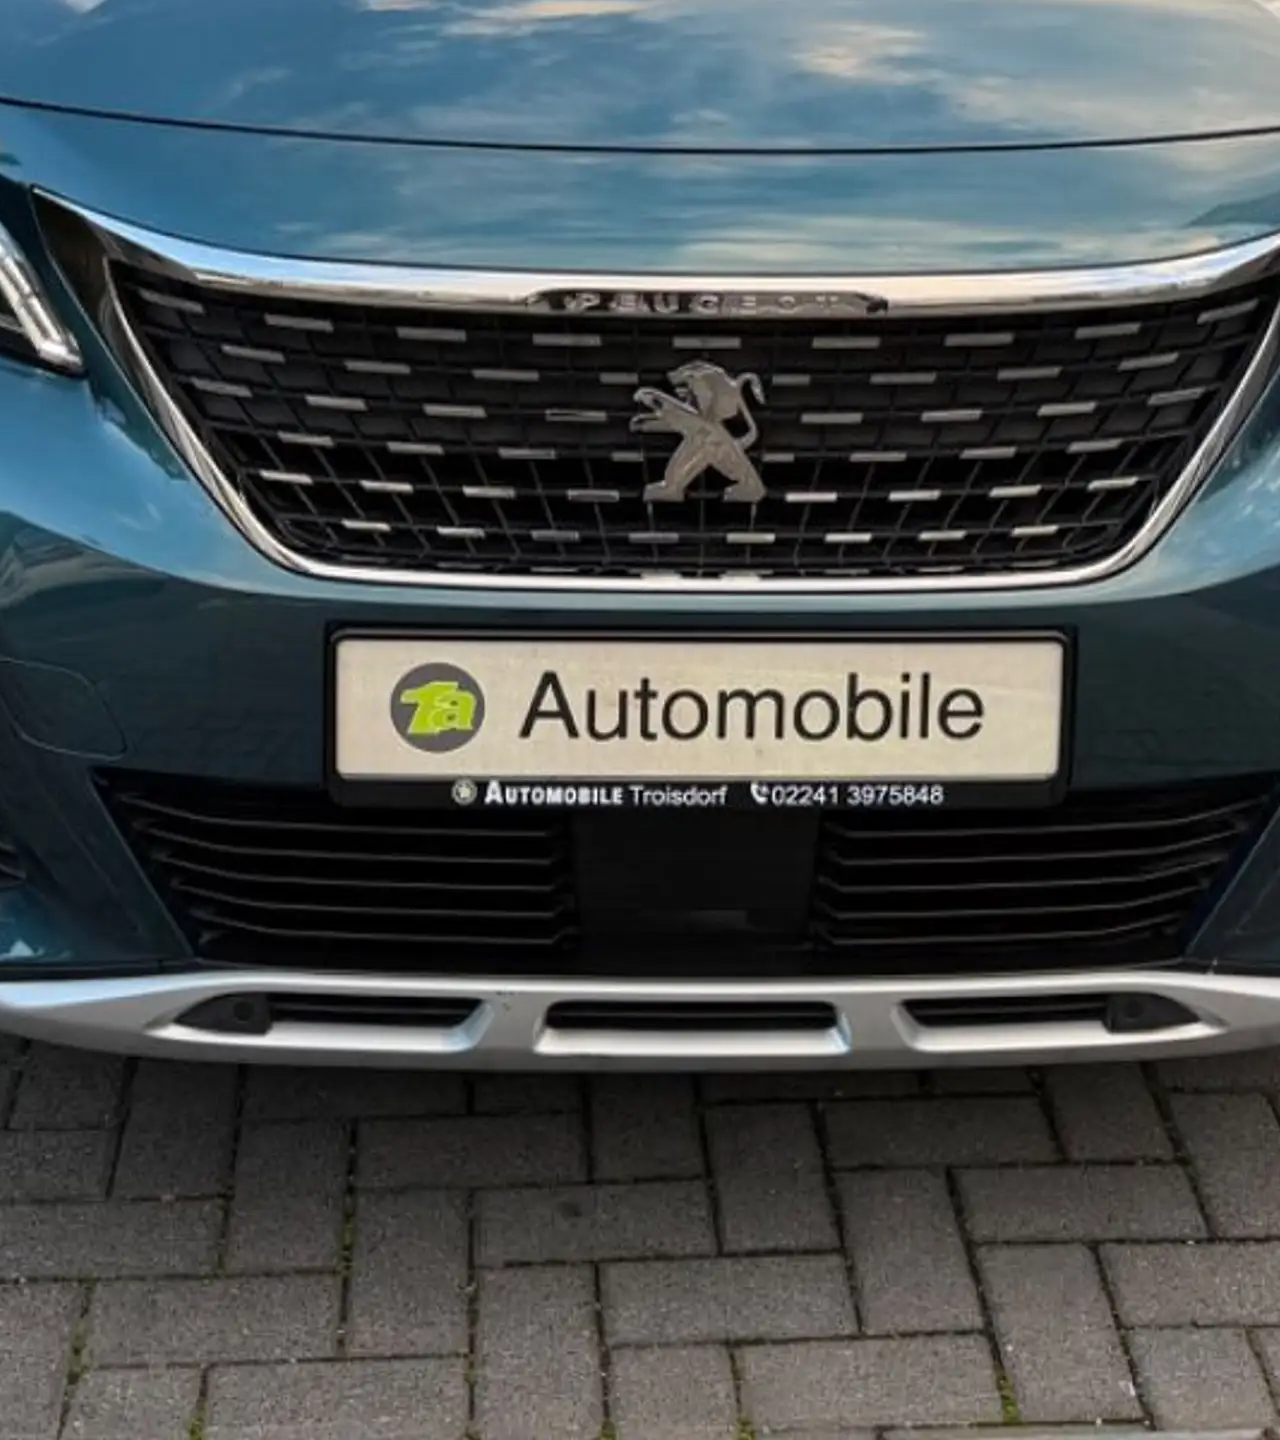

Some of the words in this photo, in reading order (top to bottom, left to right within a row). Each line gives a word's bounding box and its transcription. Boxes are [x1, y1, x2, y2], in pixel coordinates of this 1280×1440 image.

[400, 681, 476, 734] 1a
[519, 670, 985, 741] Automobile
[484, 779, 623, 805] AUTOMOBILE
[629, 784, 727, 806] Troisdorf
[771, 785, 839, 806] 02241
[847, 784, 944, 806] 3975848
